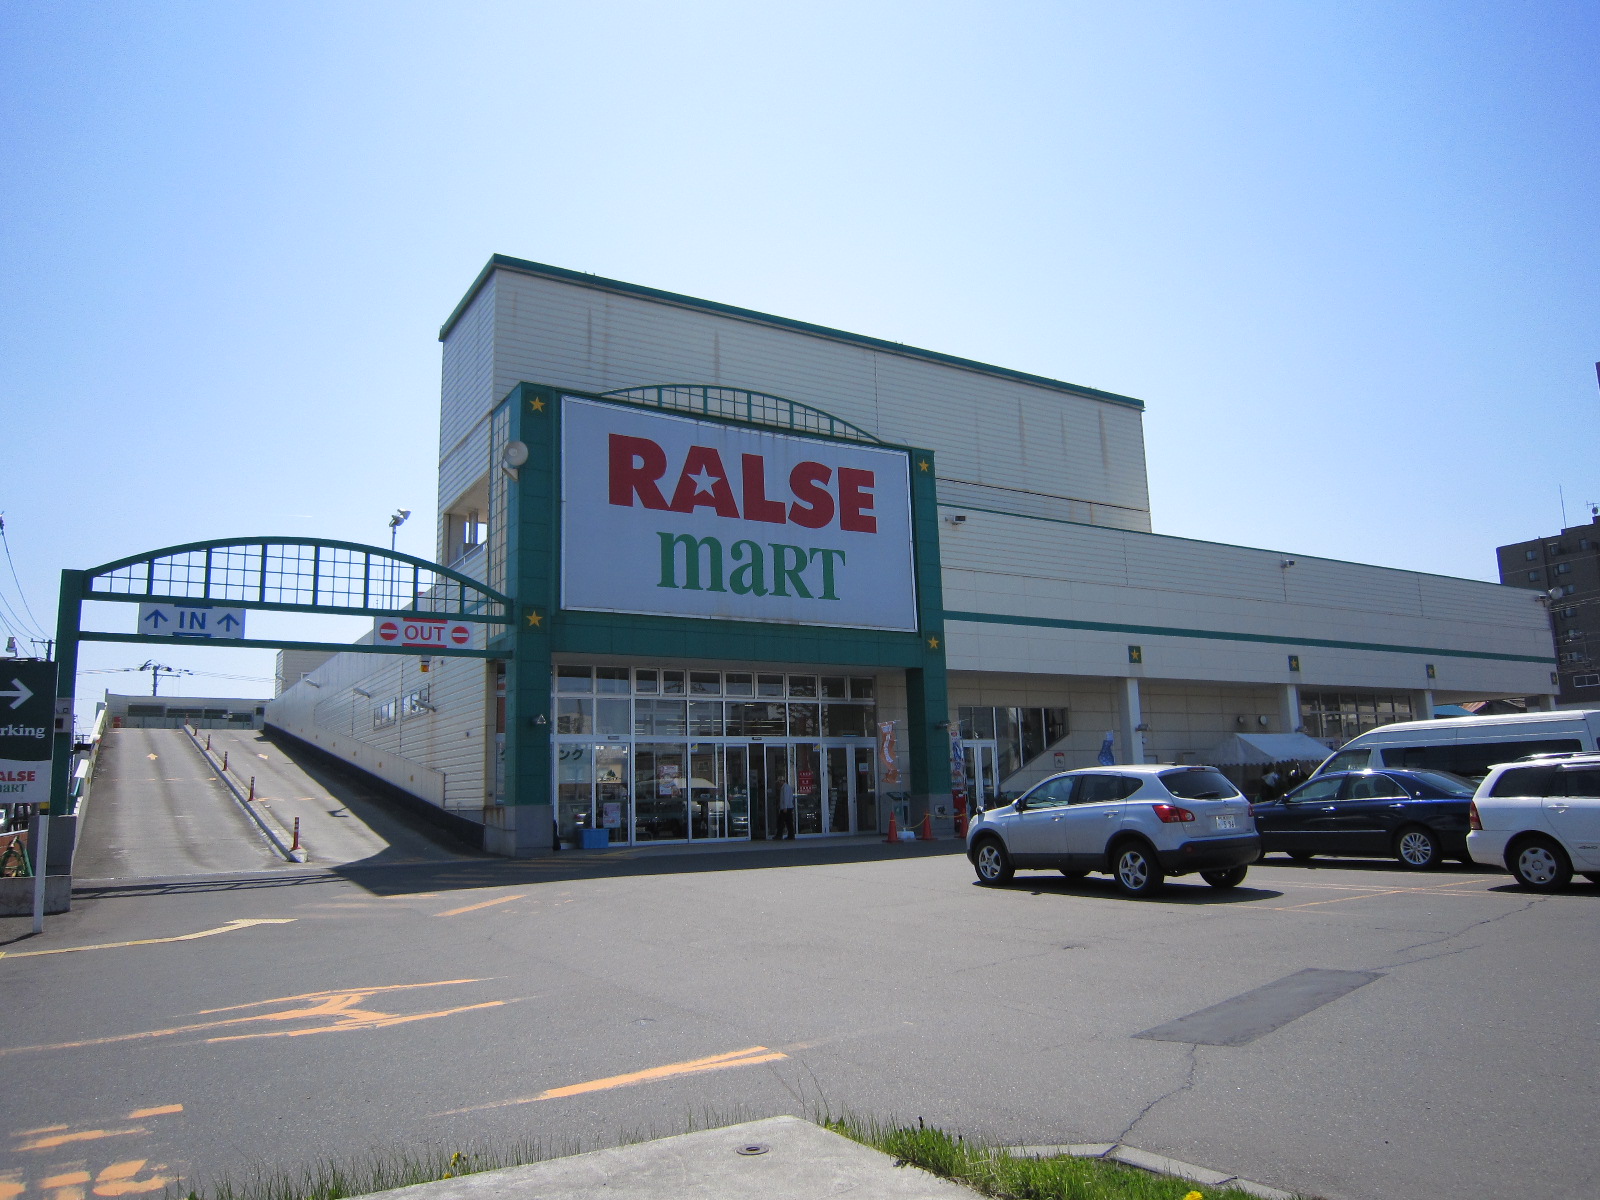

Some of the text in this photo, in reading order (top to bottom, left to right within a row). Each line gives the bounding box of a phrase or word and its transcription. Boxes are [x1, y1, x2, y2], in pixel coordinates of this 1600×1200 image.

[608, 433, 877, 534] RALSE
[179, 611, 206, 629] IN
[404, 625, 446, 641] OUT
[0, 724, 45, 739] rking
